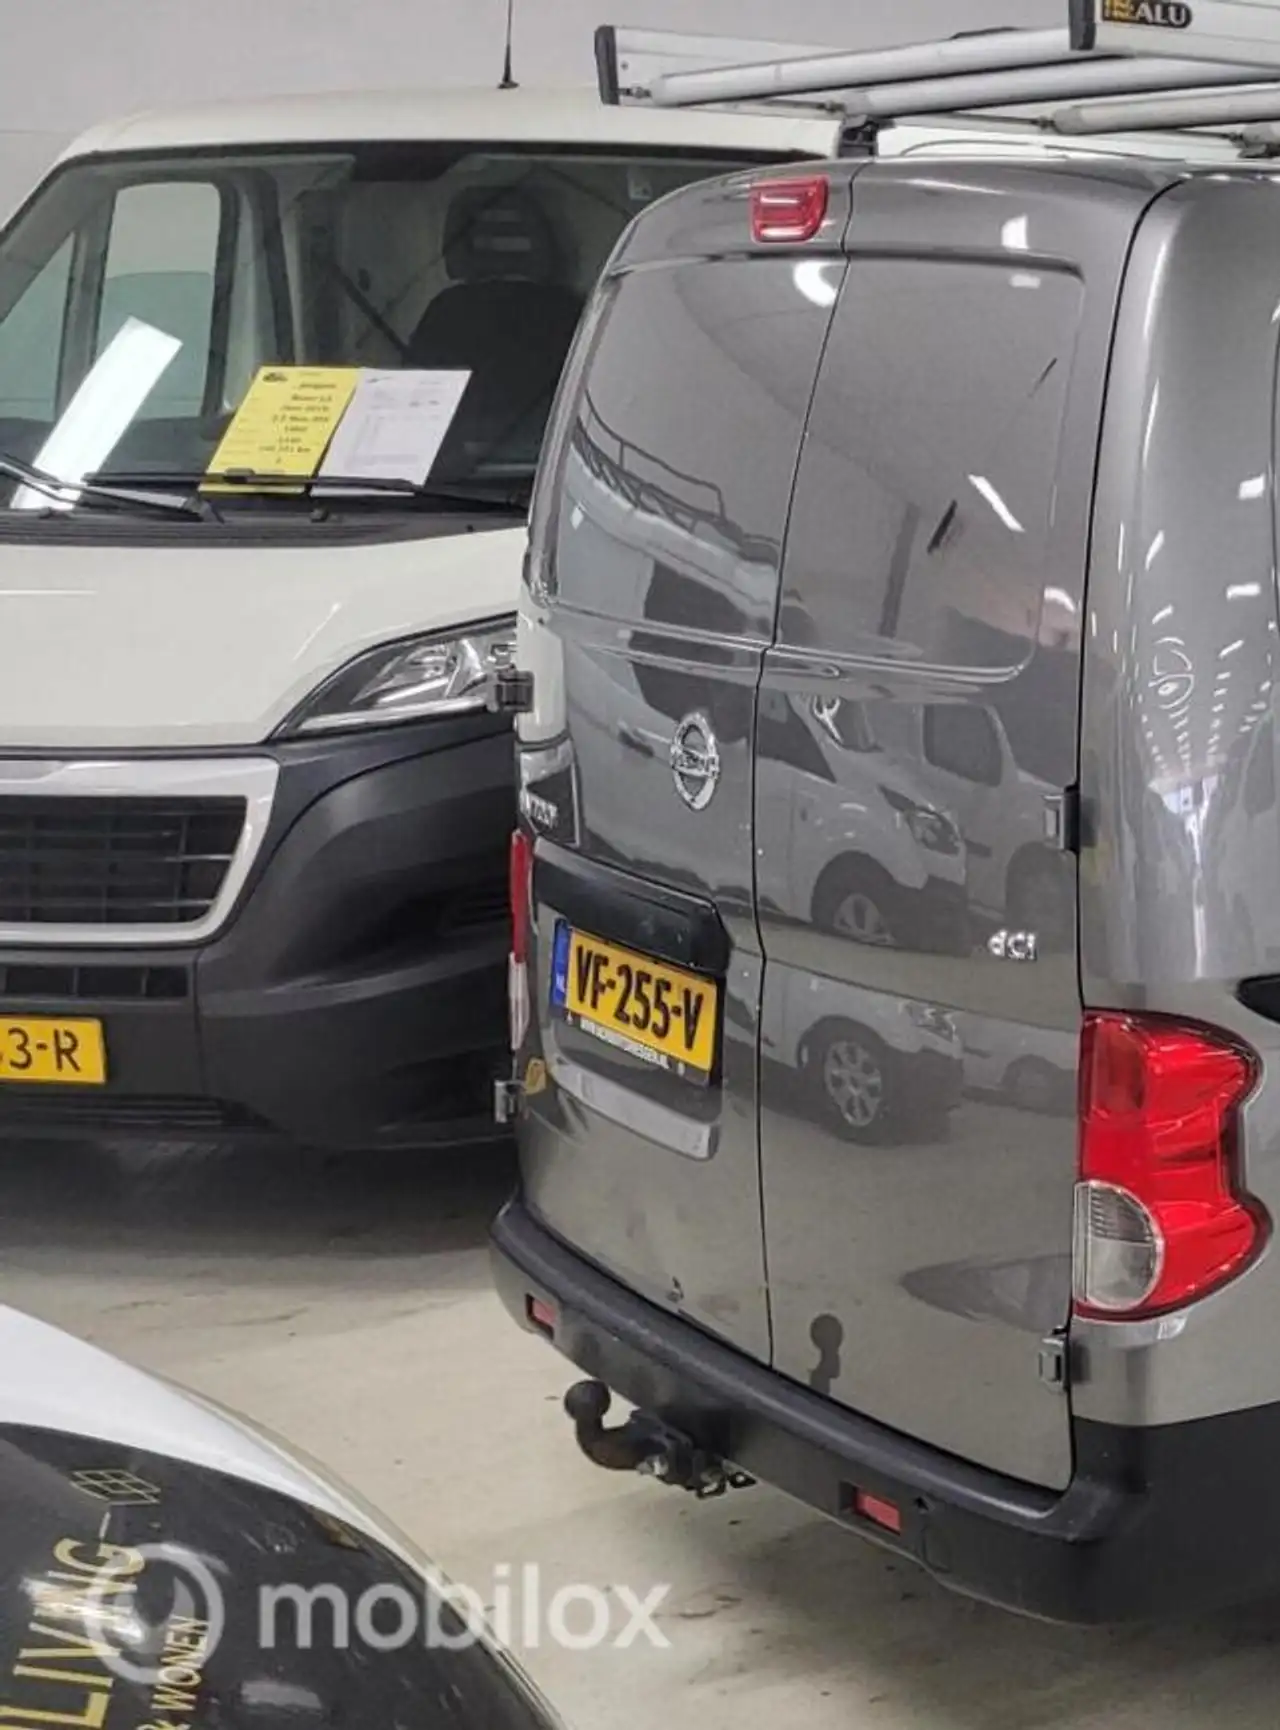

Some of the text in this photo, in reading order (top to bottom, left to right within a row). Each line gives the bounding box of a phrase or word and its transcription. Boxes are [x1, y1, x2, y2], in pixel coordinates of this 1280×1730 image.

[575, 944, 704, 1051] VF-255-V
[0, 1026, 82, 1073] 3-R
[151, 1613, 210, 1711] WONEN
